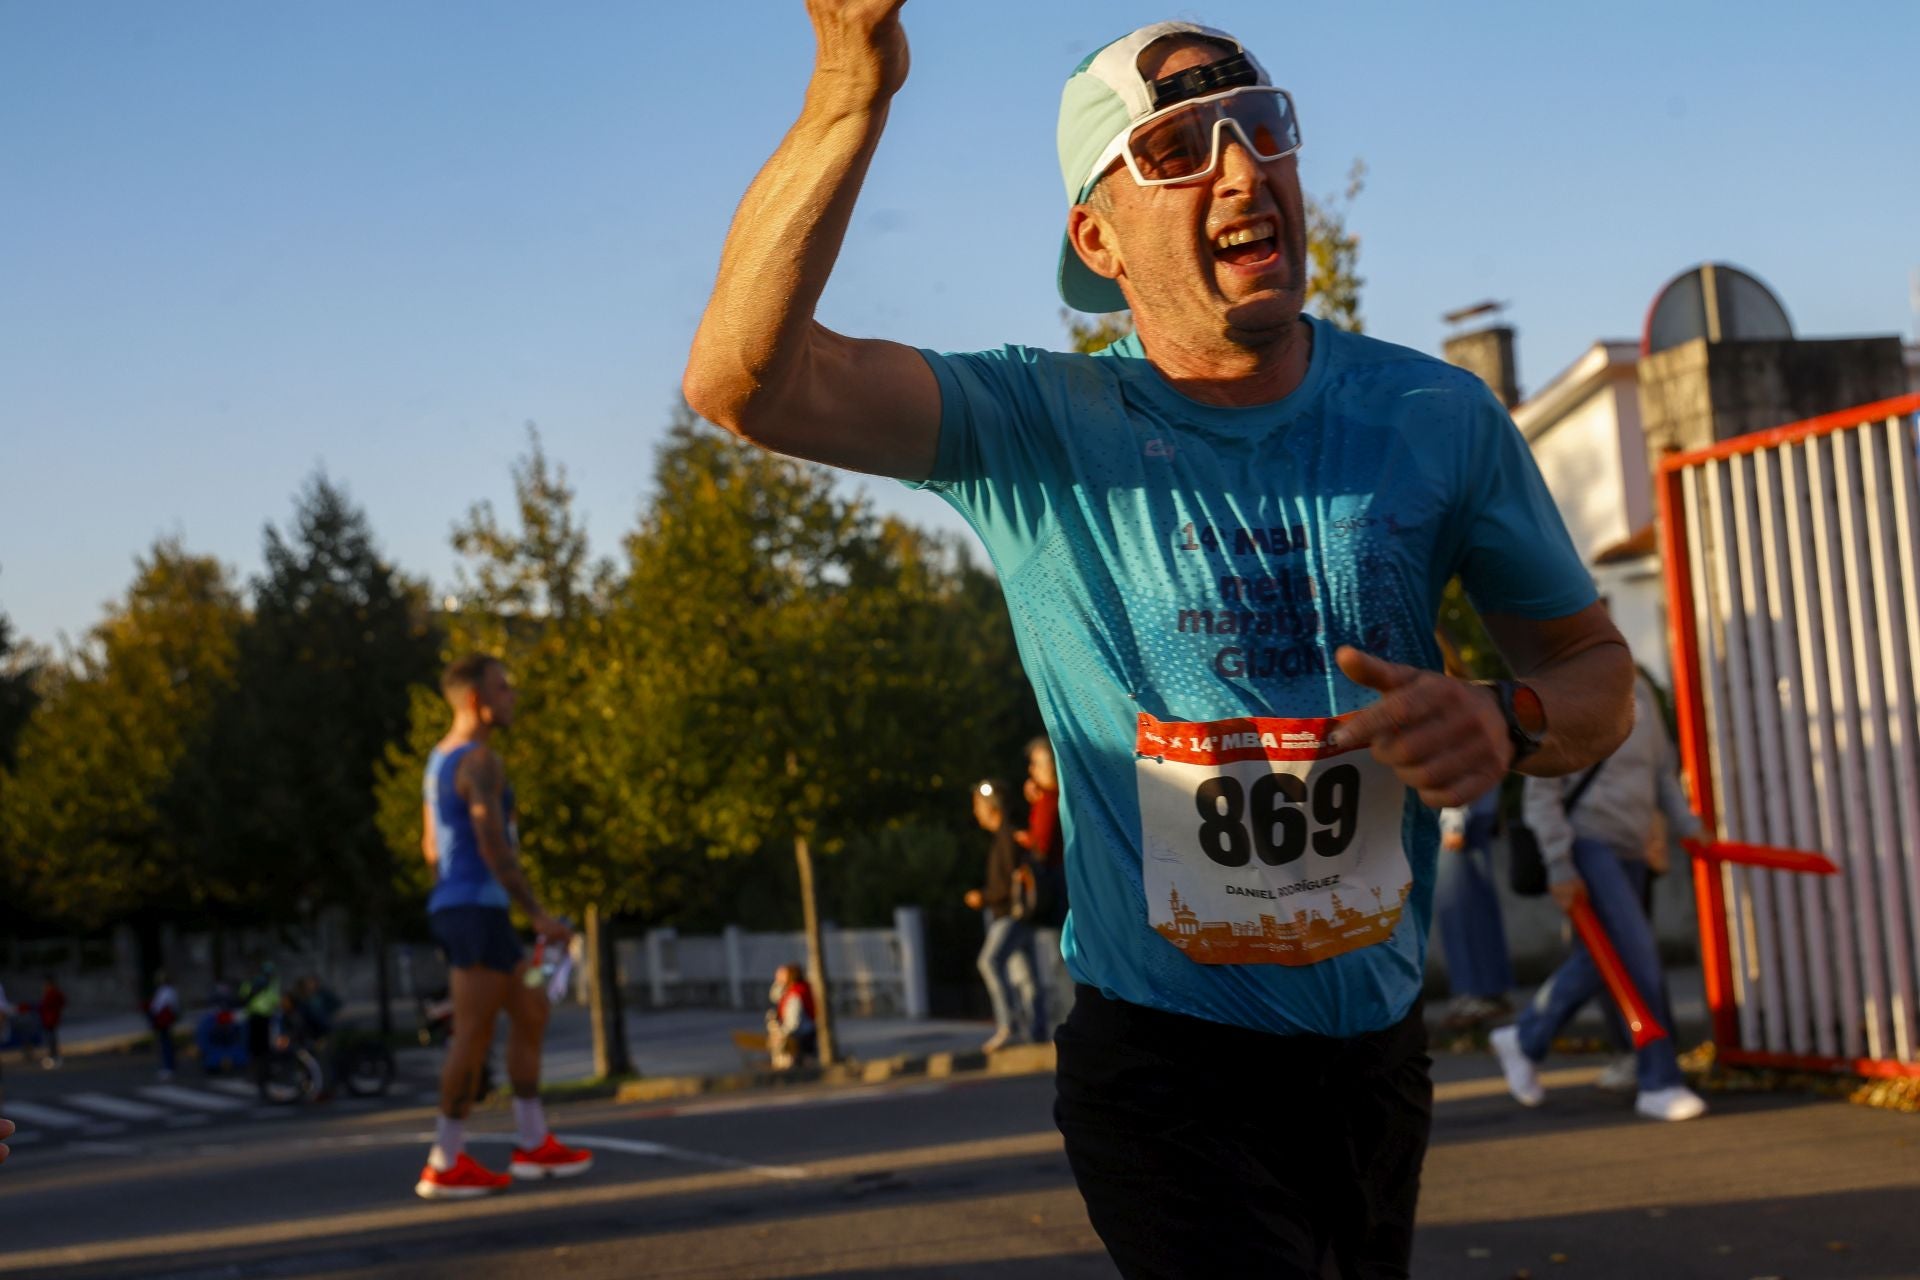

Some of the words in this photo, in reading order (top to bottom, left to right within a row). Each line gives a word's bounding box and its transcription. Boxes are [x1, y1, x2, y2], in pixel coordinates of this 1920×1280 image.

[1235, 525, 1309, 555] MBA
[1221, 732, 1278, 750] MBA
[1195, 763, 1361, 868] 869
[1225, 884, 1277, 899] DANIEL
[1277, 873, 1341, 897] RODRÍGUEZ
